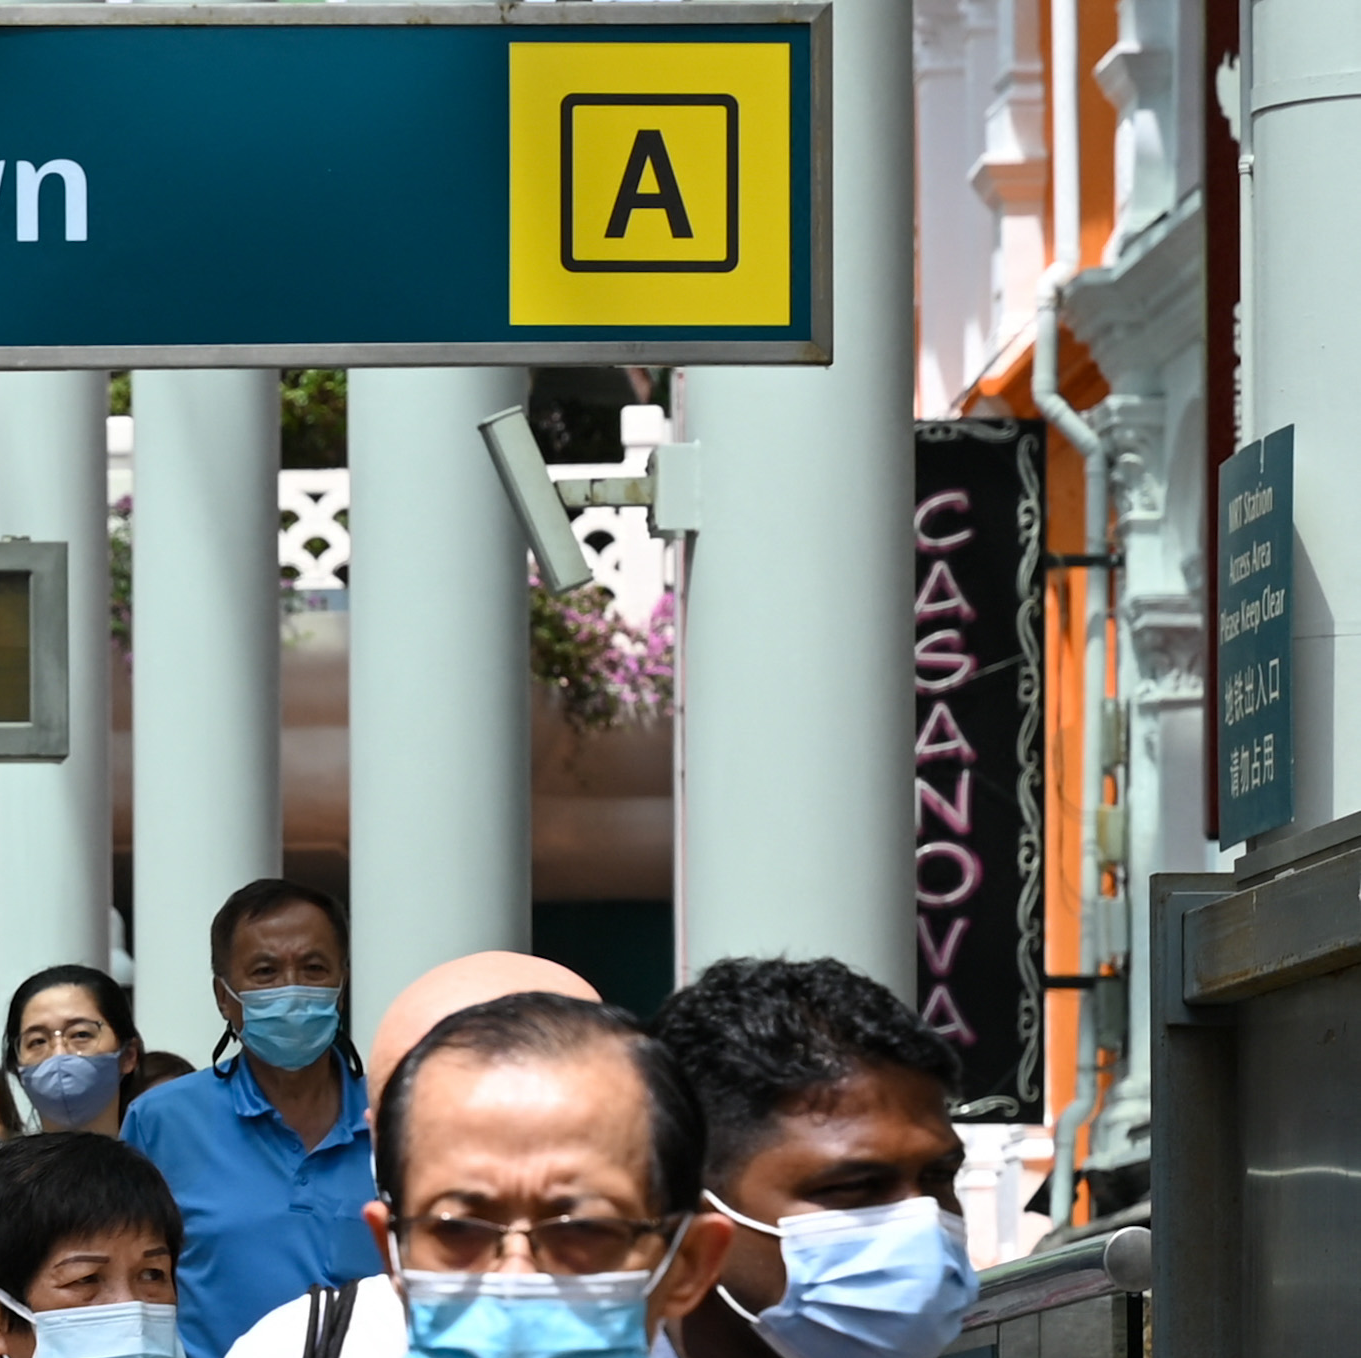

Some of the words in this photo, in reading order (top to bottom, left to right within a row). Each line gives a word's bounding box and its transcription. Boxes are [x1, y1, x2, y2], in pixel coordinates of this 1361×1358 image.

[604, 129, 694, 239] A
[1228, 495, 1243, 534] MRT
[1243, 482, 1273, 525] Station
[1229, 551, 1251, 587] Access
[1251, 540, 1272, 573] Area
[1220, 607, 1240, 646] Please
[1241, 597, 1261, 635] Keep
[1261, 584, 1286, 622] Clear
[1224, 657, 1280, 727] 地铁出入口
[914, 489, 977, 1044] CASANOVA
[1229, 733, 1275, 799] 请勿占用
